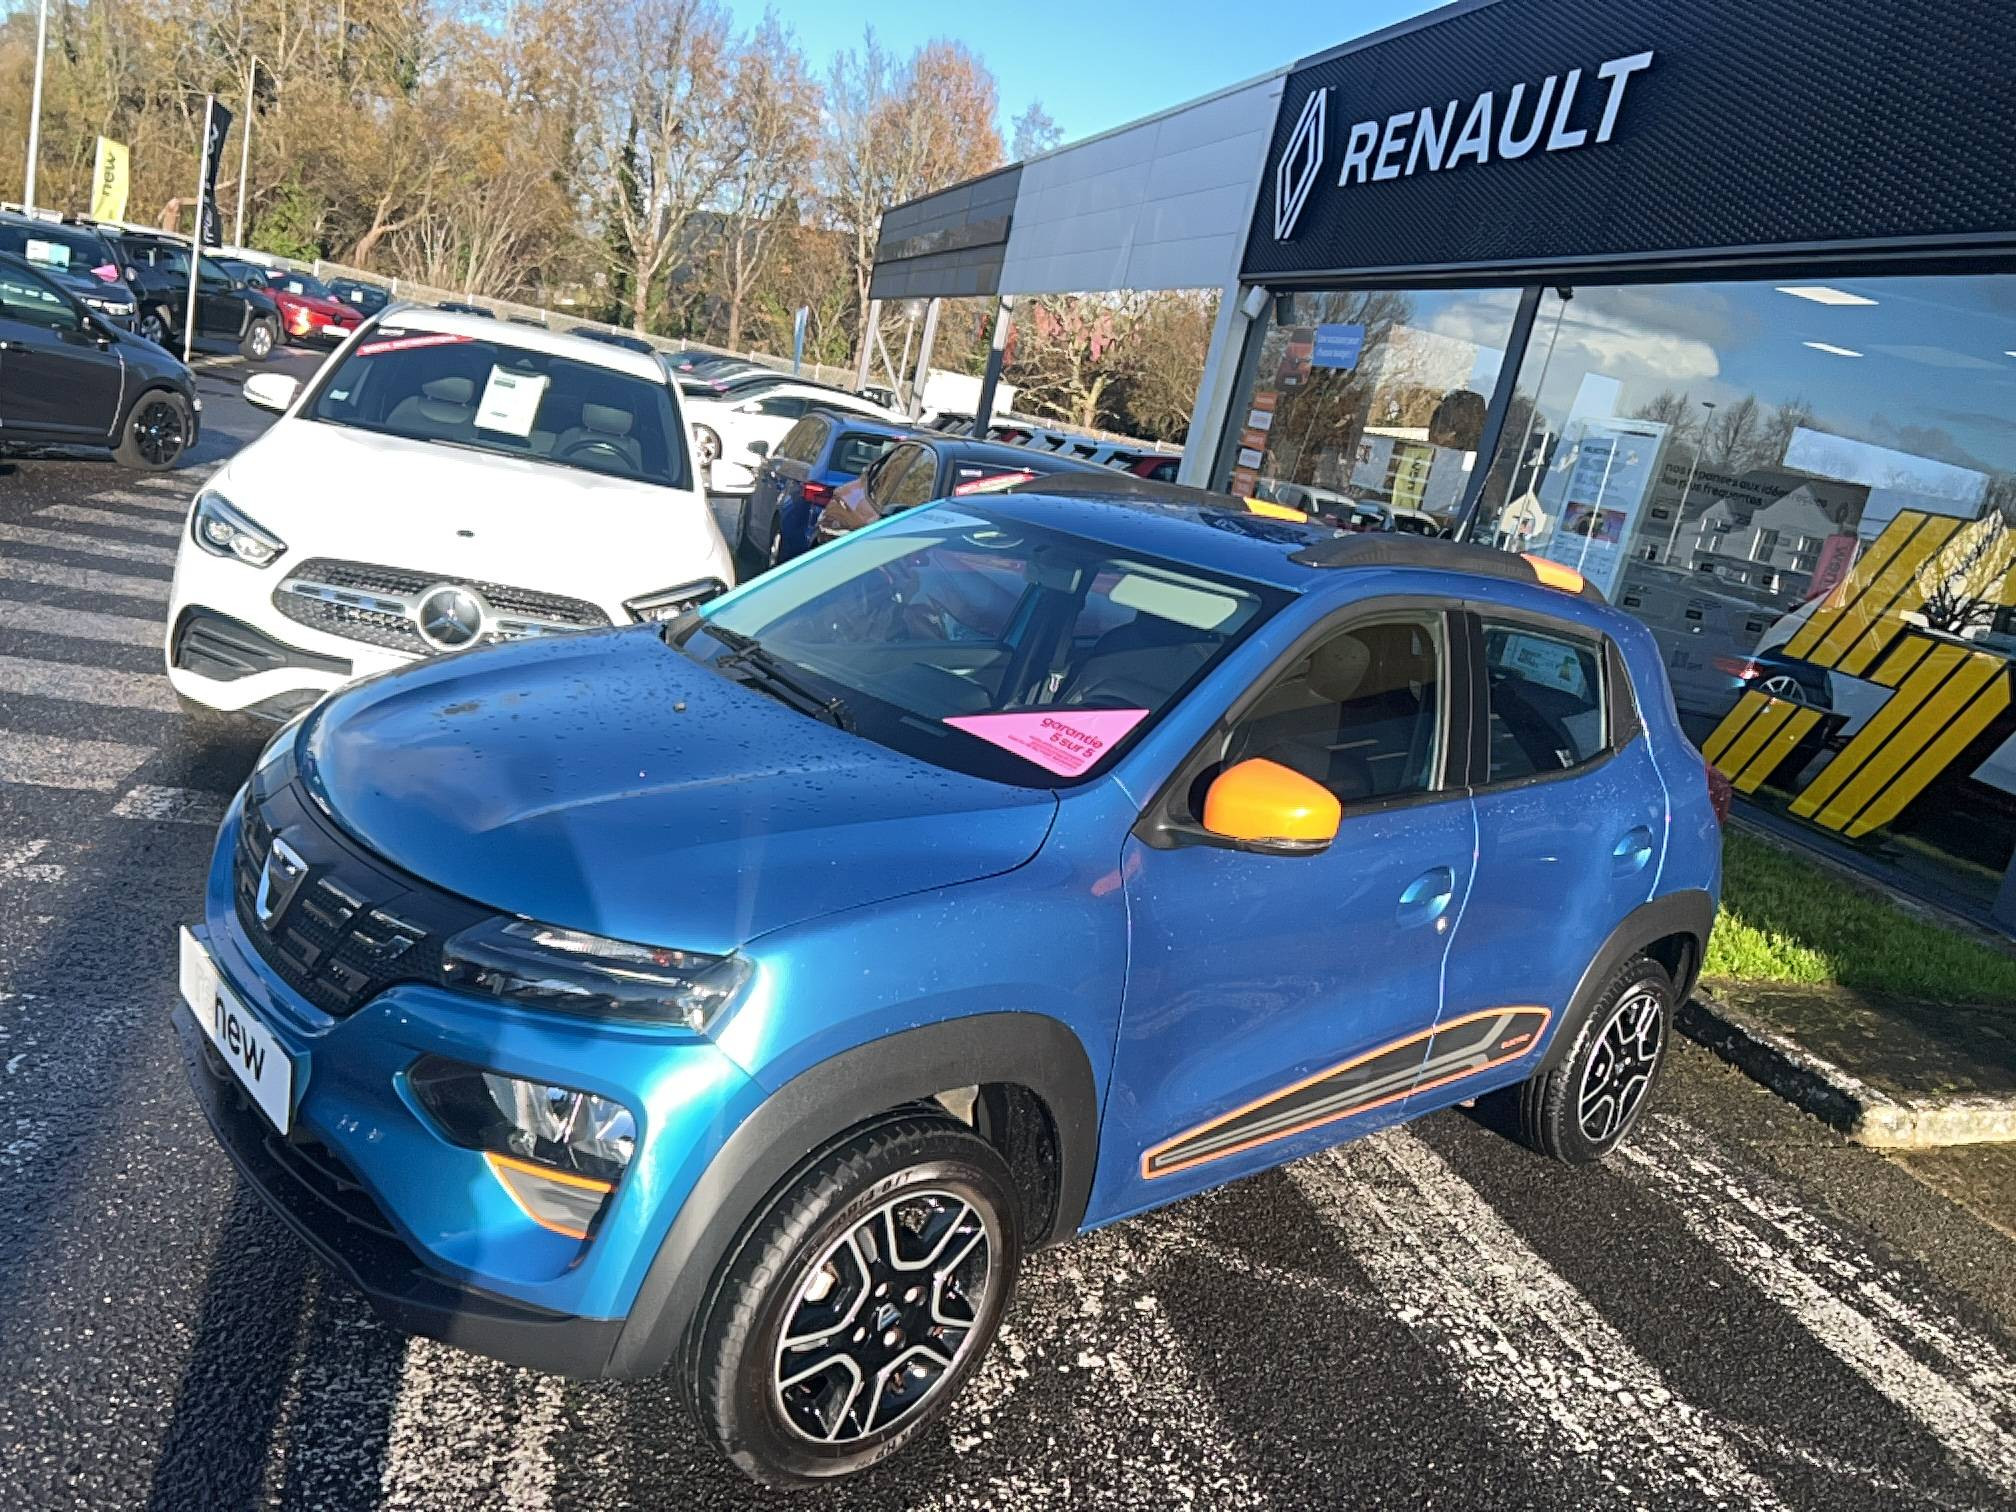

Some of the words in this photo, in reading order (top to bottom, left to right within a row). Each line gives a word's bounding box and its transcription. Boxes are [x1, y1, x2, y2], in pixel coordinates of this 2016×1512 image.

[1337, 51, 1653, 187] RENAULT
[1040, 717, 1104, 750] garantie
[1050, 732, 1060, 743] 5
[1059, 738, 1084, 753] sur
[1082, 747, 1096, 759] 5
